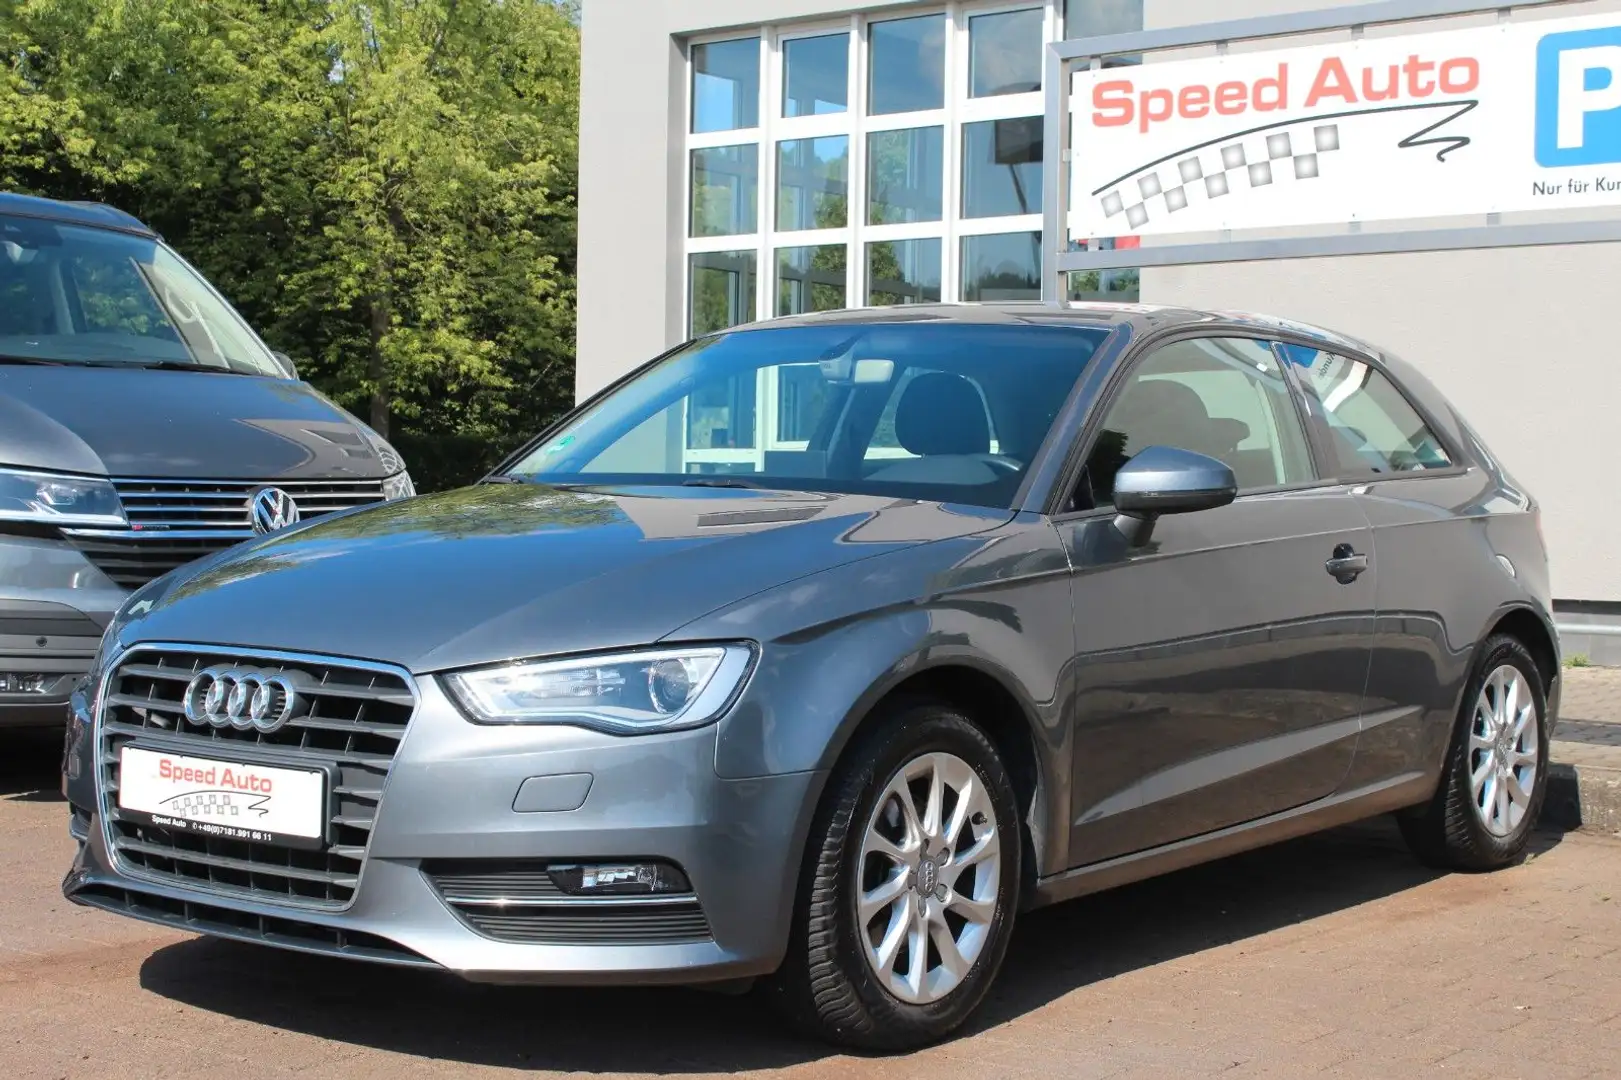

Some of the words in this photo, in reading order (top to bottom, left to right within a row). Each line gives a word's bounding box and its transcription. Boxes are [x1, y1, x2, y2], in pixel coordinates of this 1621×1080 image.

[1092, 63, 1289, 134] Speed
[1304, 55, 1480, 107] Auto
[1557, 44, 1621, 149] P
[1532, 181, 1562, 196] Nur
[1568, 178, 1589, 193] für
[159, 759, 216, 786] Speed
[220, 768, 273, 793] Auto
[151, 814, 171, 826] Speed
[172, 819, 187, 828] Auto
[263, 832, 272, 841] 11
